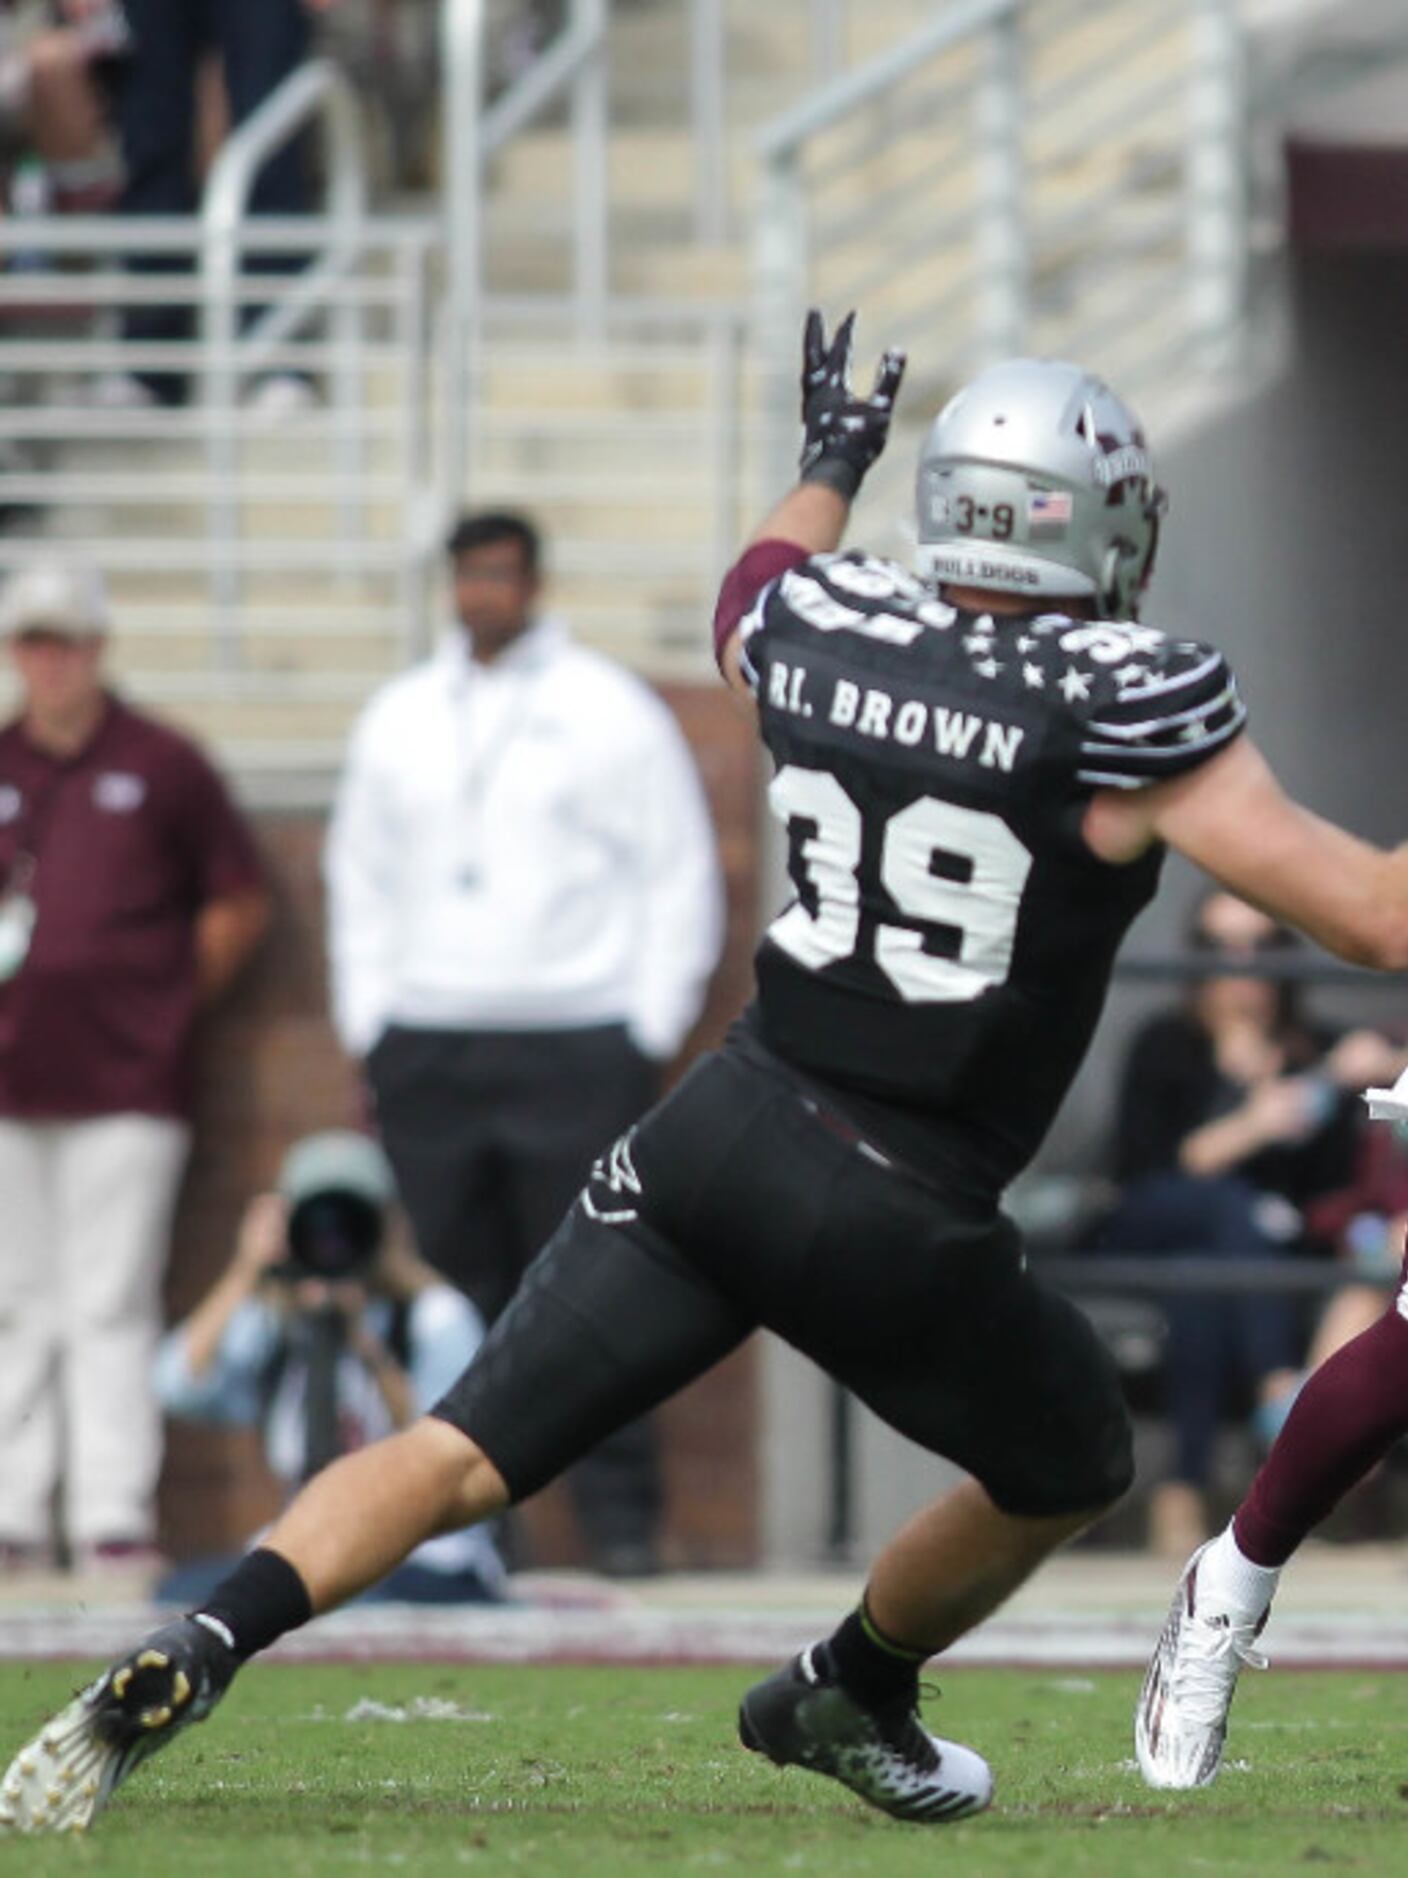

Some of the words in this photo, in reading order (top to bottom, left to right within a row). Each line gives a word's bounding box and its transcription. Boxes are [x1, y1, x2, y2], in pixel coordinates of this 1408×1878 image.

[933, 558, 1040, 584] BULLDOGS
[829, 679, 1024, 772] BROWN
[767, 764, 1034, 1003] 39
